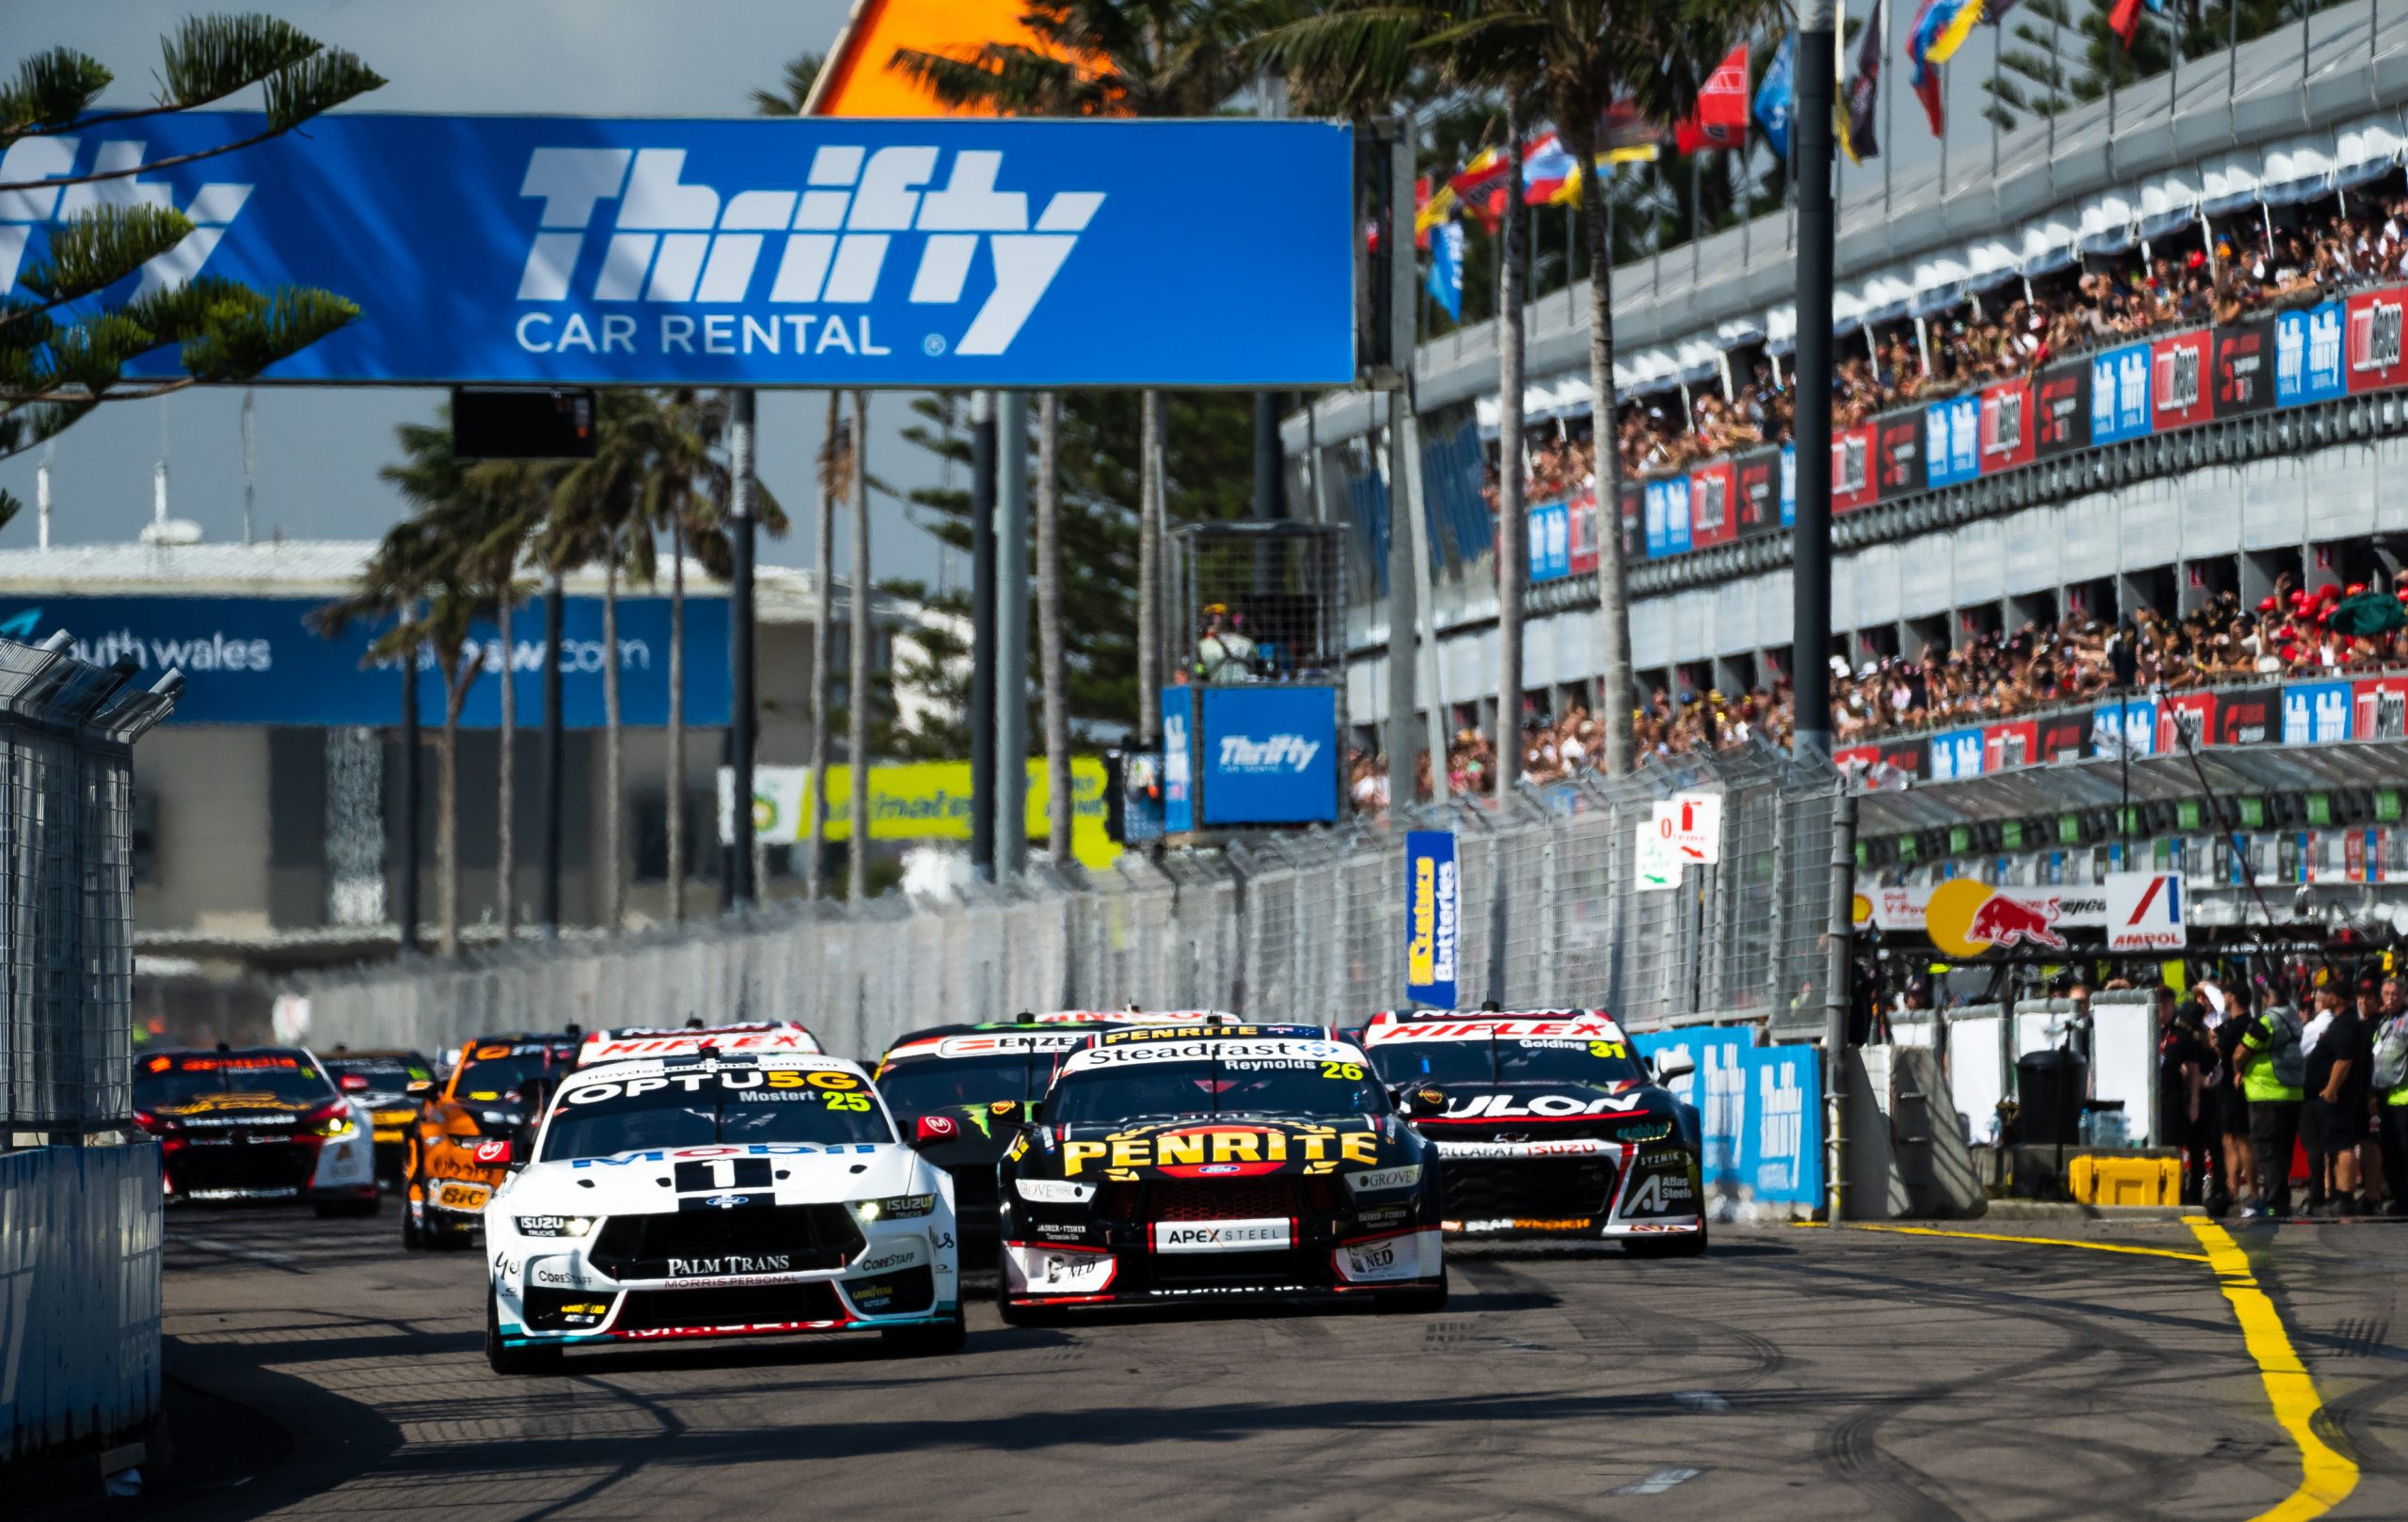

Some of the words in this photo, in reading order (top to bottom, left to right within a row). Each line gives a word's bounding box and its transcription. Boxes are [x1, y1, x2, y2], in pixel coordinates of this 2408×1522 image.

[516, 145, 1106, 355] Thrifty
[515, 312, 637, 354] CAR
[661, 313, 891, 356] RENTAL
[150, 630, 272, 671] wales
[1219, 734, 1320, 773] Thrifty
[2113, 933, 2183, 948] AMPOL
[1105, 1026, 1258, 1044] PENRITE
[1380, 1023, 1605, 1039] HIFLEX
[1088, 1041, 1291, 1066] Steadfast
[1519, 1039, 1587, 1052] Golding
[1589, 1040, 1626, 1059] 31
[1225, 1058, 1316, 1070] Reynolds
[1320, 1060, 1364, 1081] 26
[739, 1090, 817, 1103] Mostert
[822, 1090, 872, 1113] 25
[572, 1144, 876, 1168] Mobil
[1064, 1131, 1379, 1177] PENRITE
[1439, 1147, 1514, 1157] ALLARAT
[1527, 1144, 1596, 1156] ISUZU
[702, 1159, 736, 1188] 1
[1662, 1177, 1688, 1187] Atlas
[1662, 1188, 1692, 1199] Steels
[886, 1197, 931, 1211] ISUZU
[521, 1216, 563, 1229] ISUZU
[1168, 1226, 1221, 1246] APEX
[1225, 1229, 1279, 1241] STEEL
[668, 1258, 718, 1277] PALM
[724, 1255, 790, 1275] TRANS
[1365, 1248, 1394, 1268] NED
[1068, 1260, 1096, 1280] NED
[664, 1279, 725, 1289] MORRIS
[729, 1276, 799, 1286] PERSONAL
